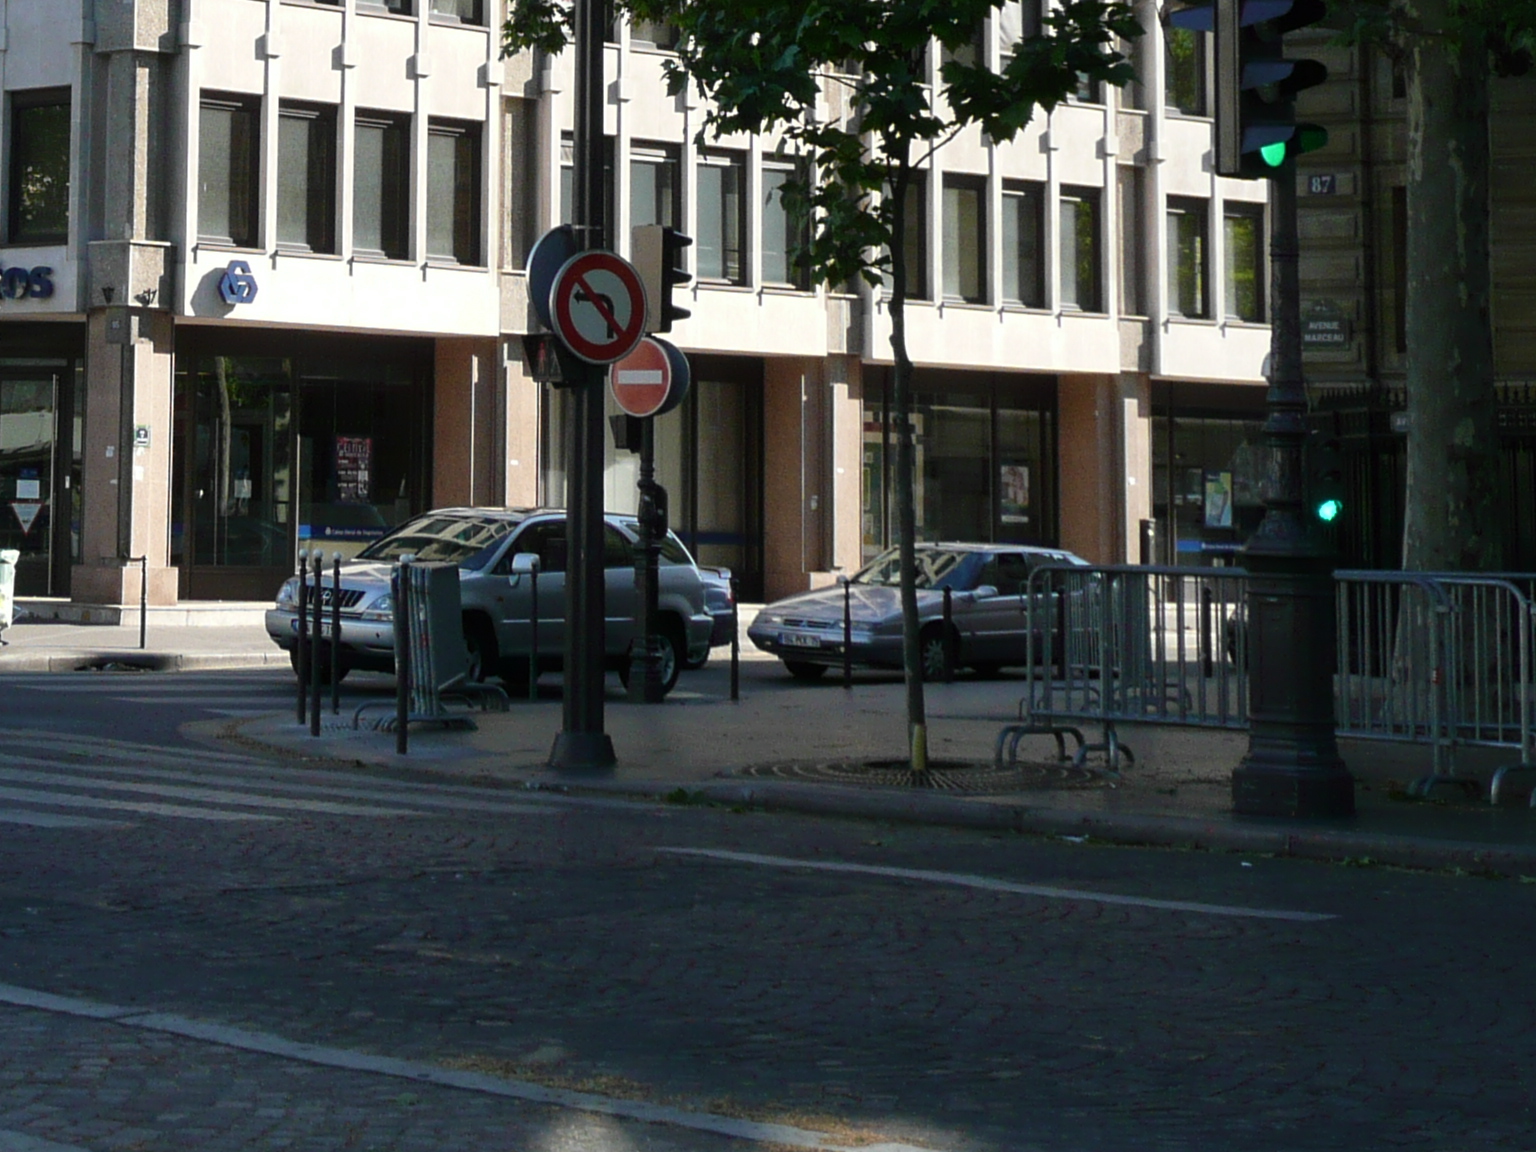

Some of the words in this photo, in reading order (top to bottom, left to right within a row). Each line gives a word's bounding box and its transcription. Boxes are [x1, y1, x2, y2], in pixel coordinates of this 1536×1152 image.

[1311, 176, 1331, 194] 87
[1308, 321, 1340, 330] AVENUE
[1304, 333, 1345, 342] MARCEAU
